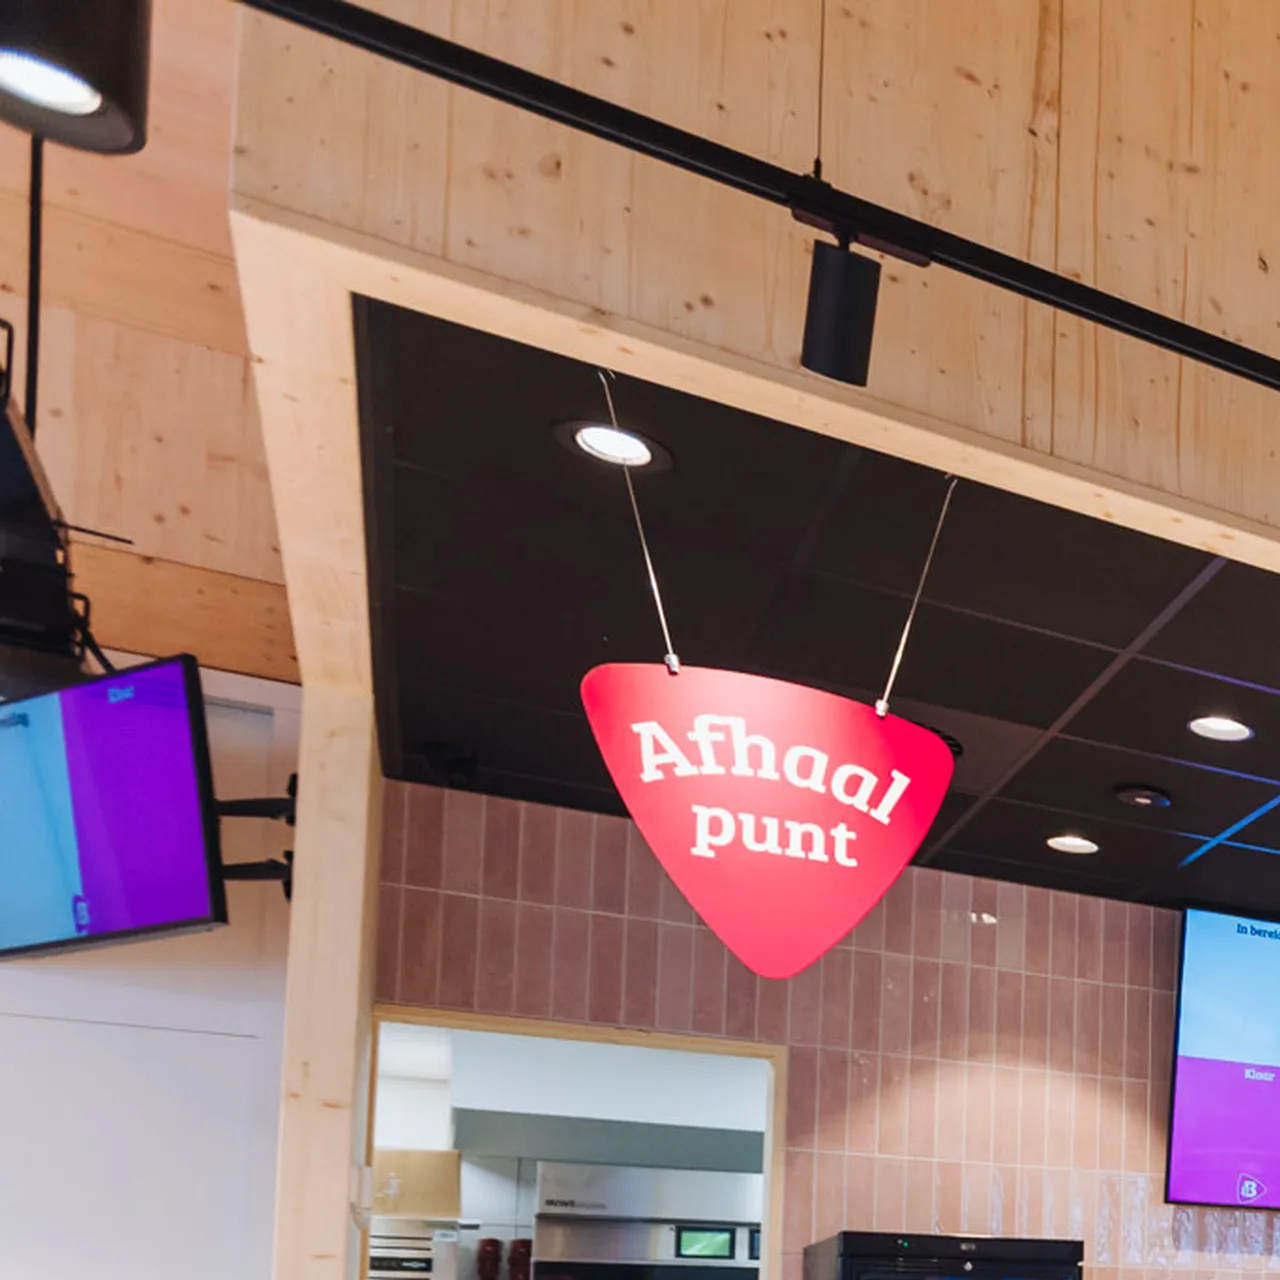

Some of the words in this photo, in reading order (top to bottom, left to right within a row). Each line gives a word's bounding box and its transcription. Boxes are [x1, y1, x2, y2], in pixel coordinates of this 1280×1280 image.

[630, 712, 912, 826] Afhaal
[690, 803, 858, 867] punt
[1236, 923, 1248, 936] In
